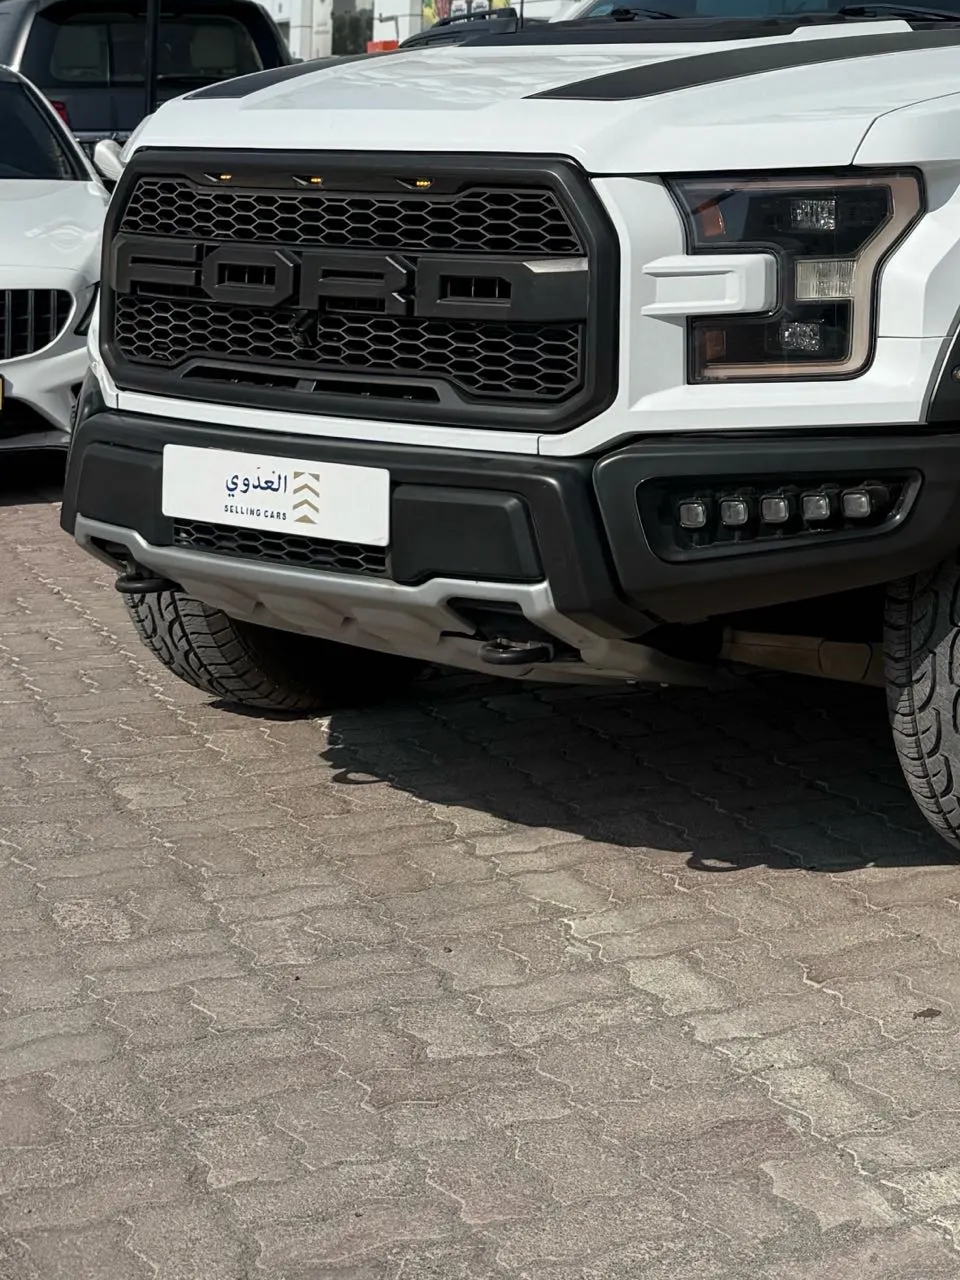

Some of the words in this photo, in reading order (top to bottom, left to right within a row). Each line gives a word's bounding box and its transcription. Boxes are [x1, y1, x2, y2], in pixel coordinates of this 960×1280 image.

[111, 234, 548, 320] FORD
[224, 505, 262, 517] SELLING
[264, 509, 287, 521] CARS
